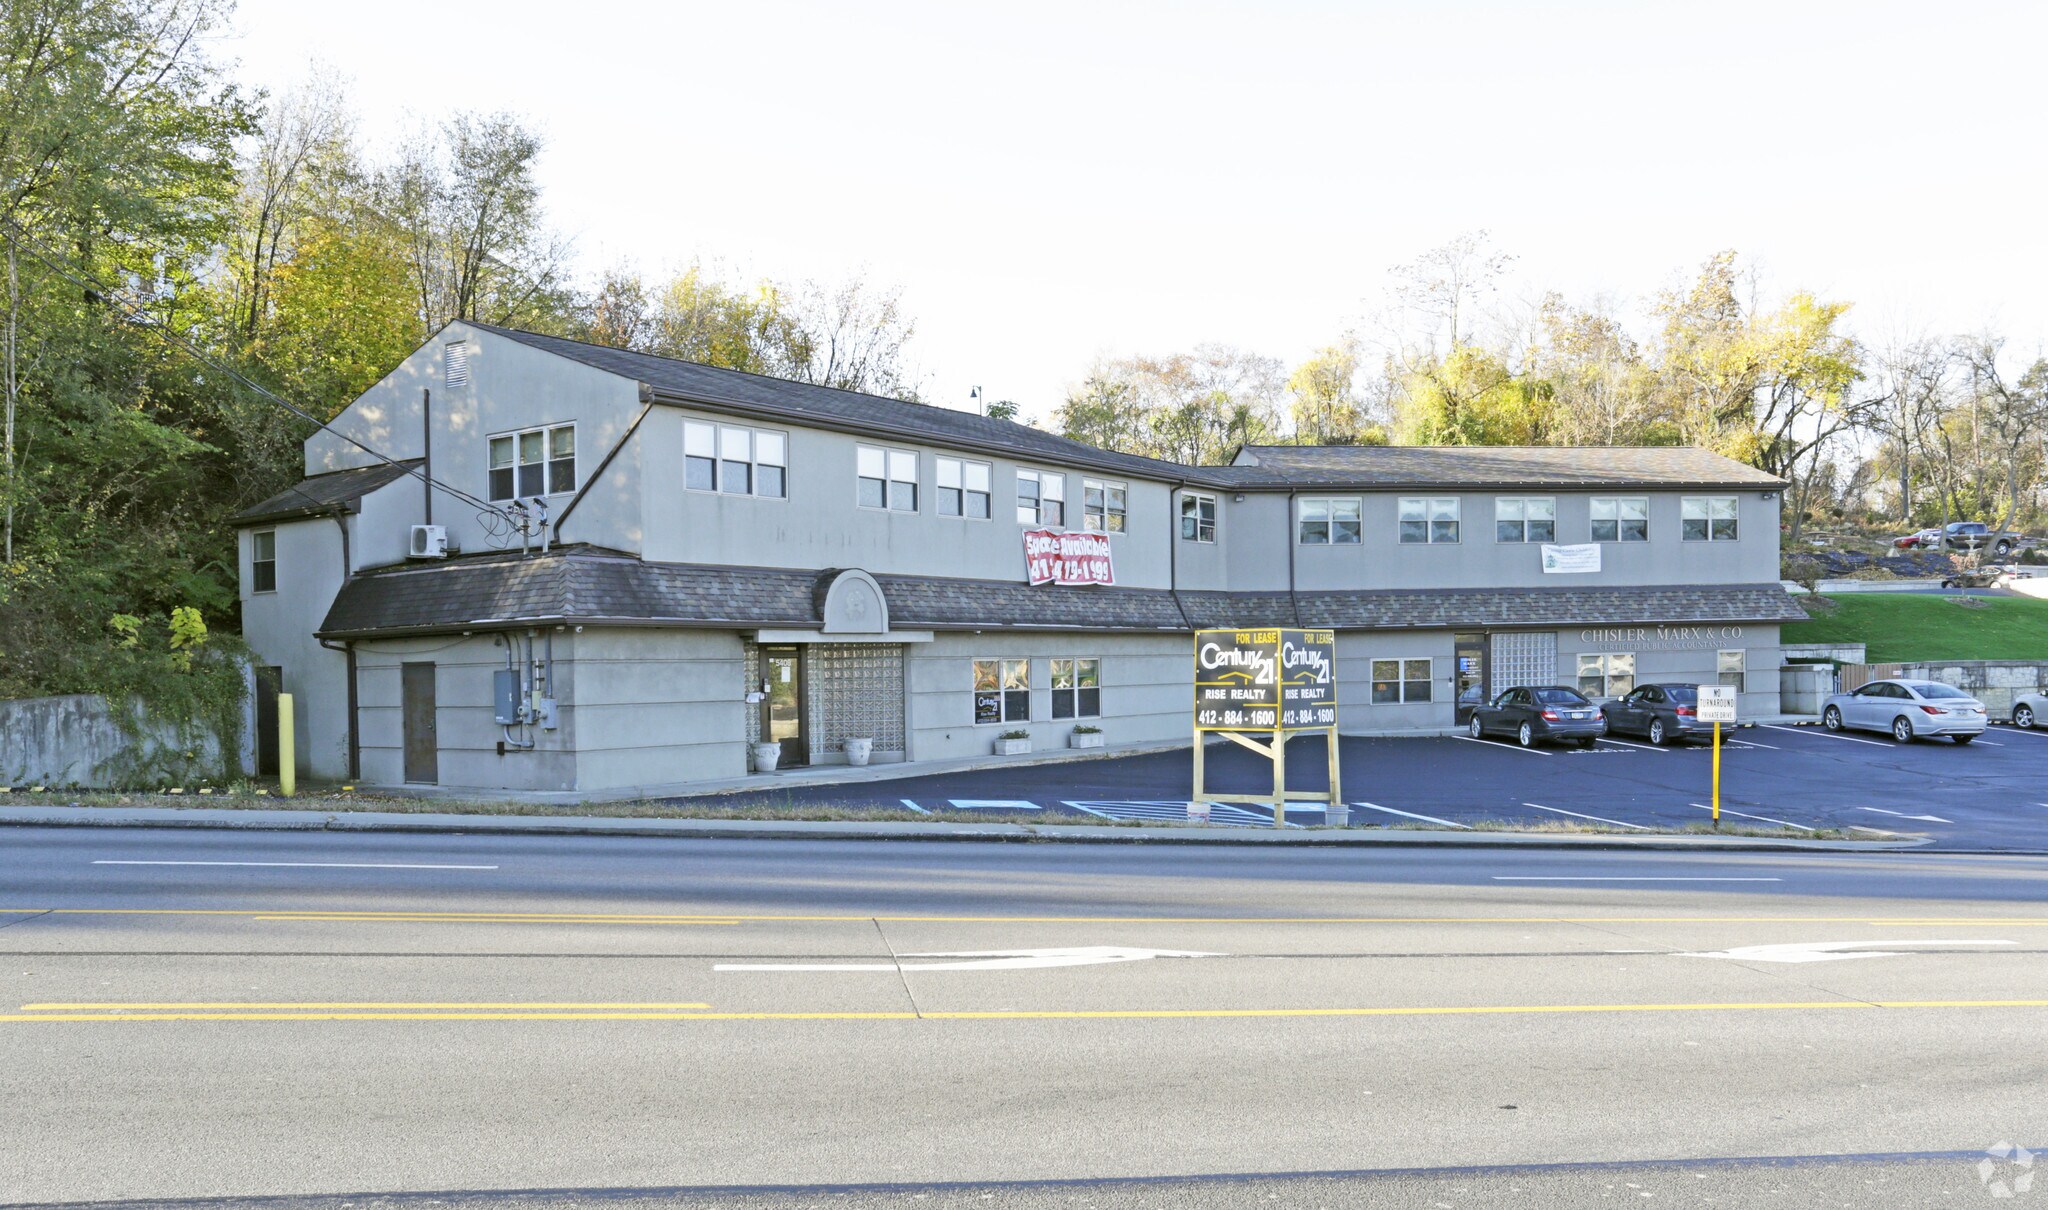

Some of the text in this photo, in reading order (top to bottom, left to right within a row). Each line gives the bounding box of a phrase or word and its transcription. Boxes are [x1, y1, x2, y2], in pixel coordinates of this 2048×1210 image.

[1026, 535, 1109, 557] Space Available
[1236, 633, 1276, 644] FOR LEASE
[1657, 627, 1700, 640] MARX
[1706, 627, 1715, 639] &
[1721, 626, 1744, 639] CO.
[1304, 634, 1332, 644] FOR LEASE
[1642, 642, 1669, 650] PUBLIC
[1673, 641, 1727, 649] ACCOUNTANTS
[1201, 642, 1273, 684] Century 21
[1282, 641, 1330, 684] Century 21
[1205, 689, 1265, 699] RISE REALTY
[1285, 688, 1325, 699] RISE REALTY
[1714, 689, 1721, 697] NO
[1700, 699, 1734, 707] TURNAROUND
